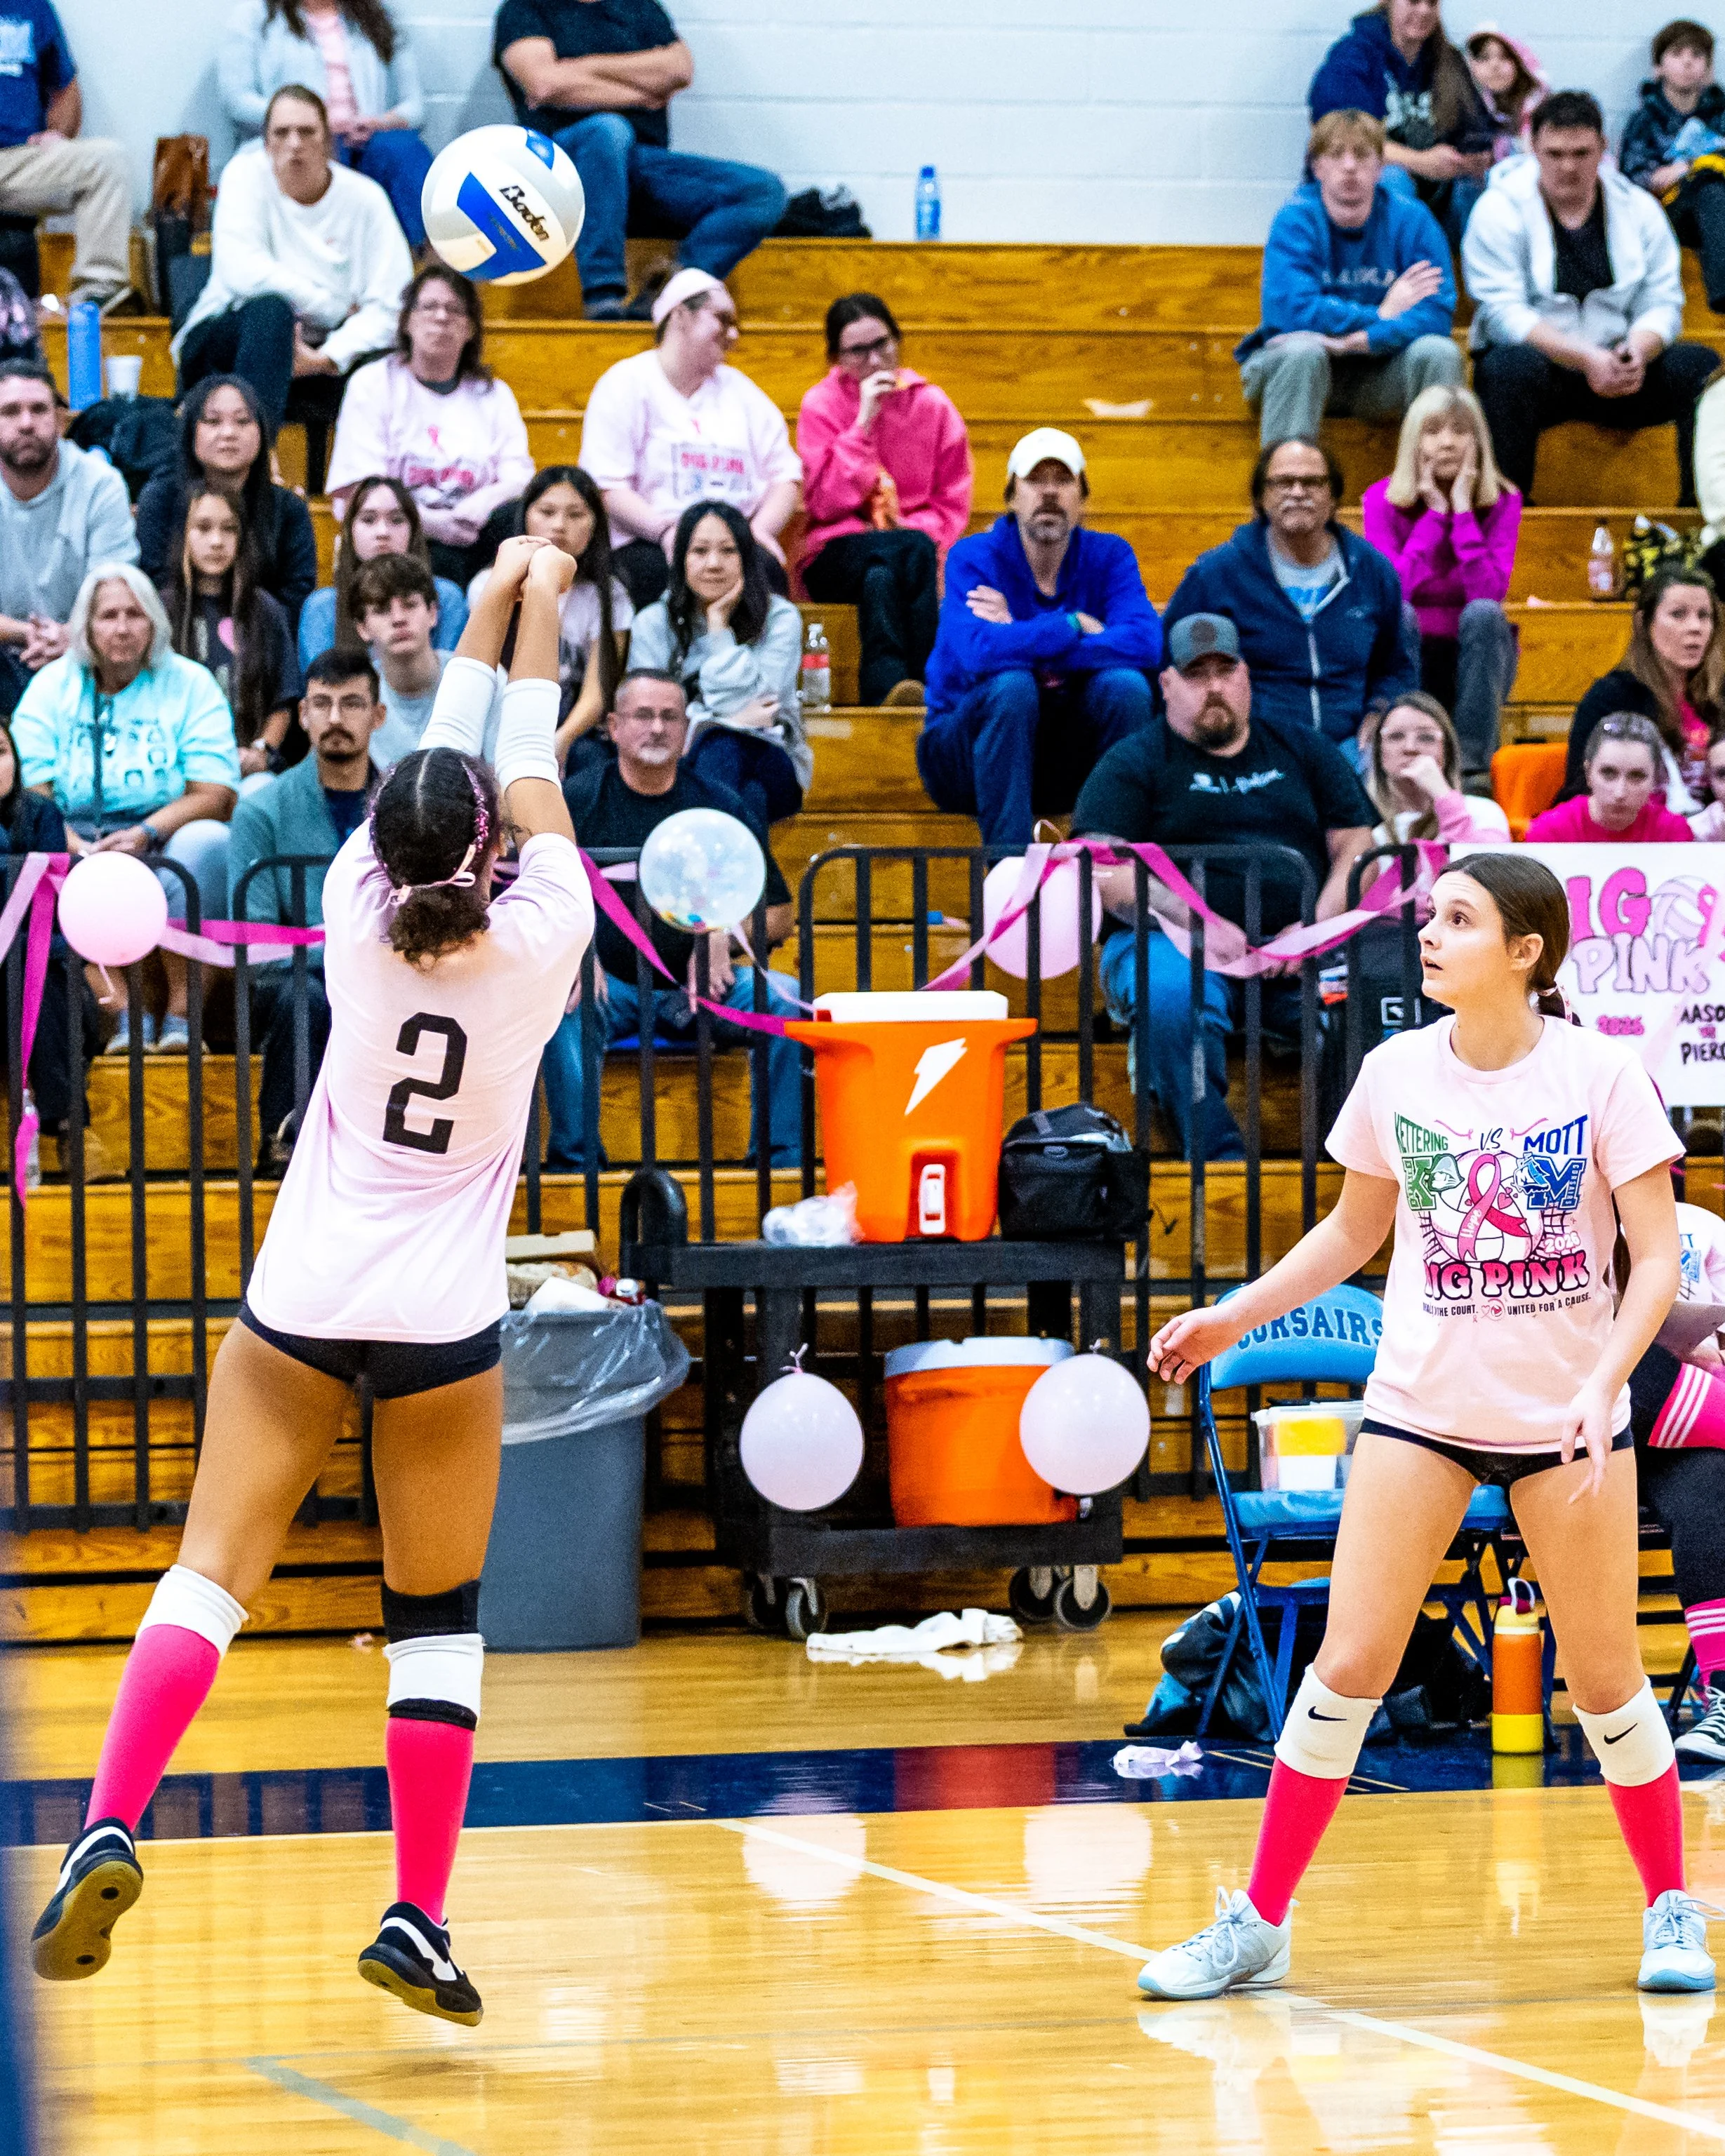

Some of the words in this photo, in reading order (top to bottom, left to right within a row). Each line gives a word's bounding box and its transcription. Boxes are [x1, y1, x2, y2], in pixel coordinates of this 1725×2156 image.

[1566, 866, 1651, 944] IG
[1569, 932, 1710, 994] PINK
[383, 1012, 467, 1154] 2
[1394, 1111, 1448, 1153] KETTERING
[1524, 1114, 1587, 1155] MOTT
[1565, 1164, 1580, 1205] CORSAIRS
[1461, 1210, 1482, 1238] Hope
[1545, 1231, 1580, 1253] 2026
[1480, 1250, 1590, 1299] PINK
[1451, 1304, 1479, 1316] COURT.
[1507, 1303, 1536, 1315] UNITED
[1538, 1301, 1555, 1312] FOR
[1558, 1299, 1563, 1308] A
